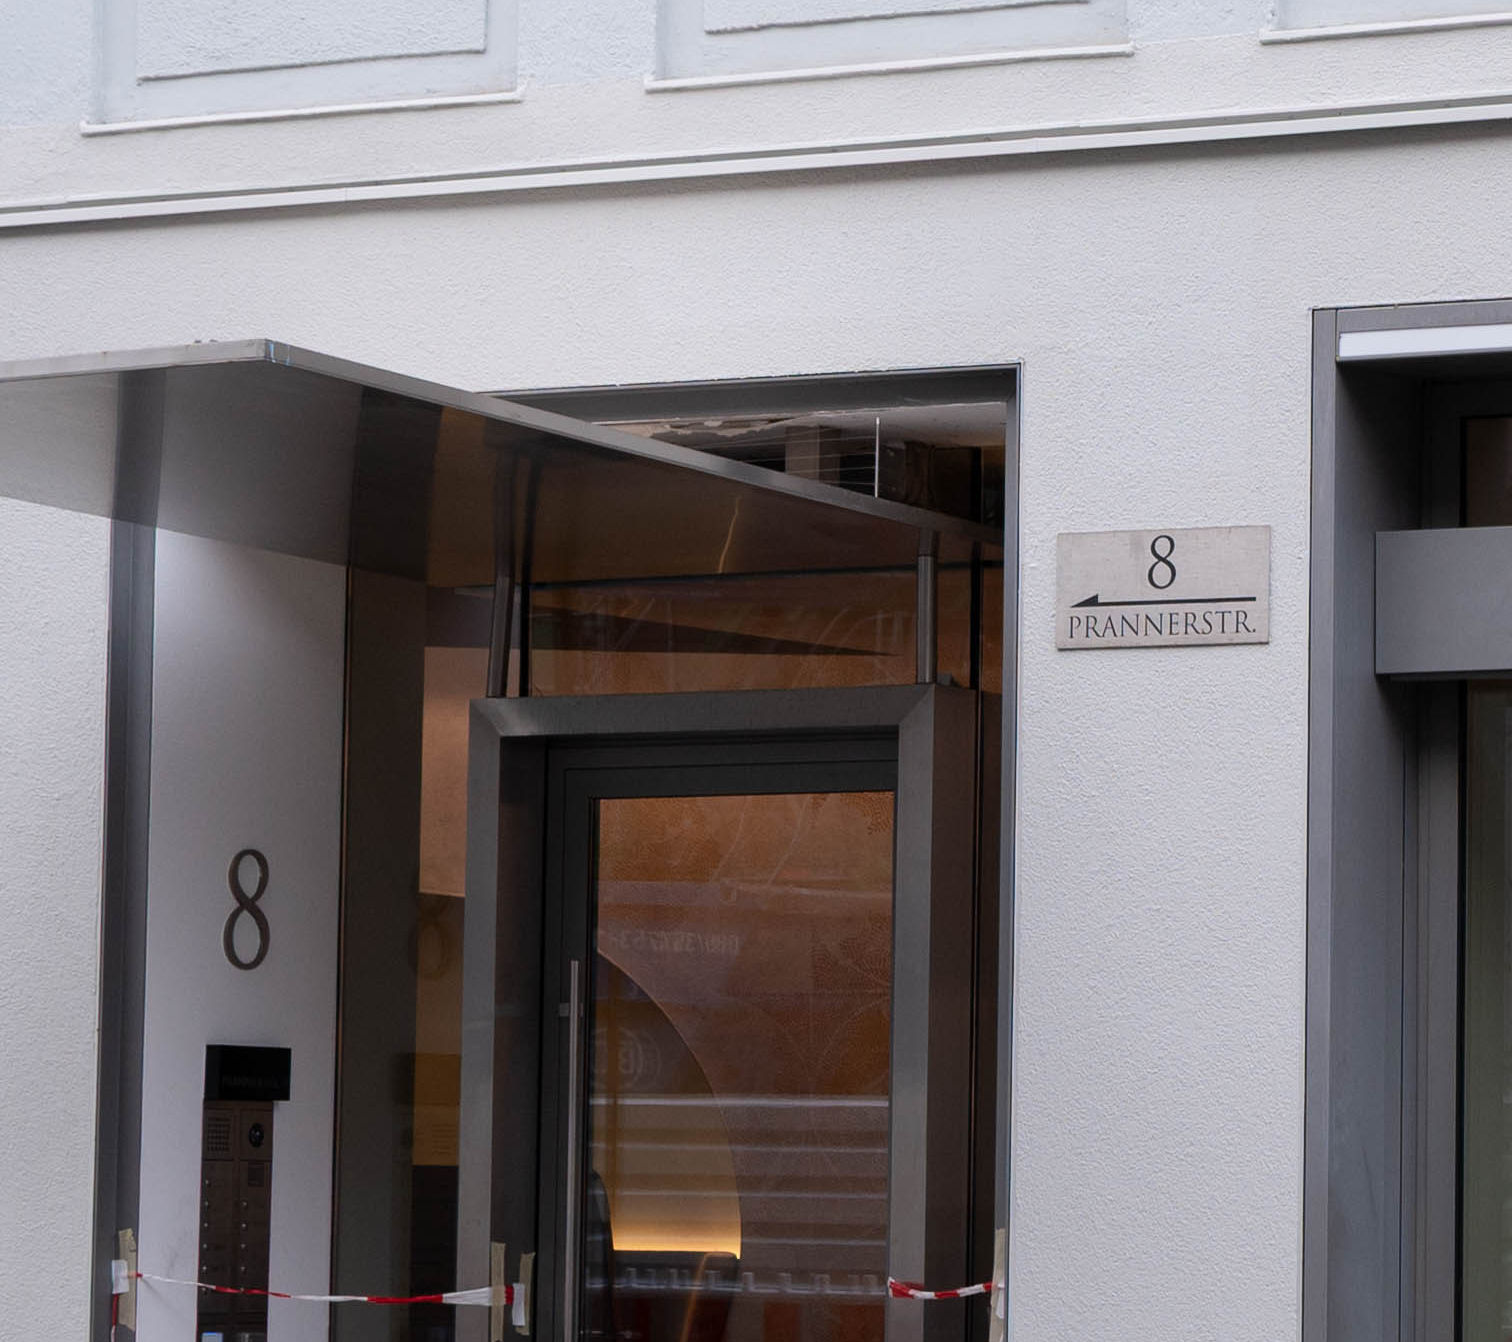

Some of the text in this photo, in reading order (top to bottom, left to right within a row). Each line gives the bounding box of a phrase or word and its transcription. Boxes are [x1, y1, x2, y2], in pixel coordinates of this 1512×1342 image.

[1147, 534, 1178, 589] 8
[1068, 610, 1257, 639] PRANNERSTR.
[222, 847, 271, 971] 8
